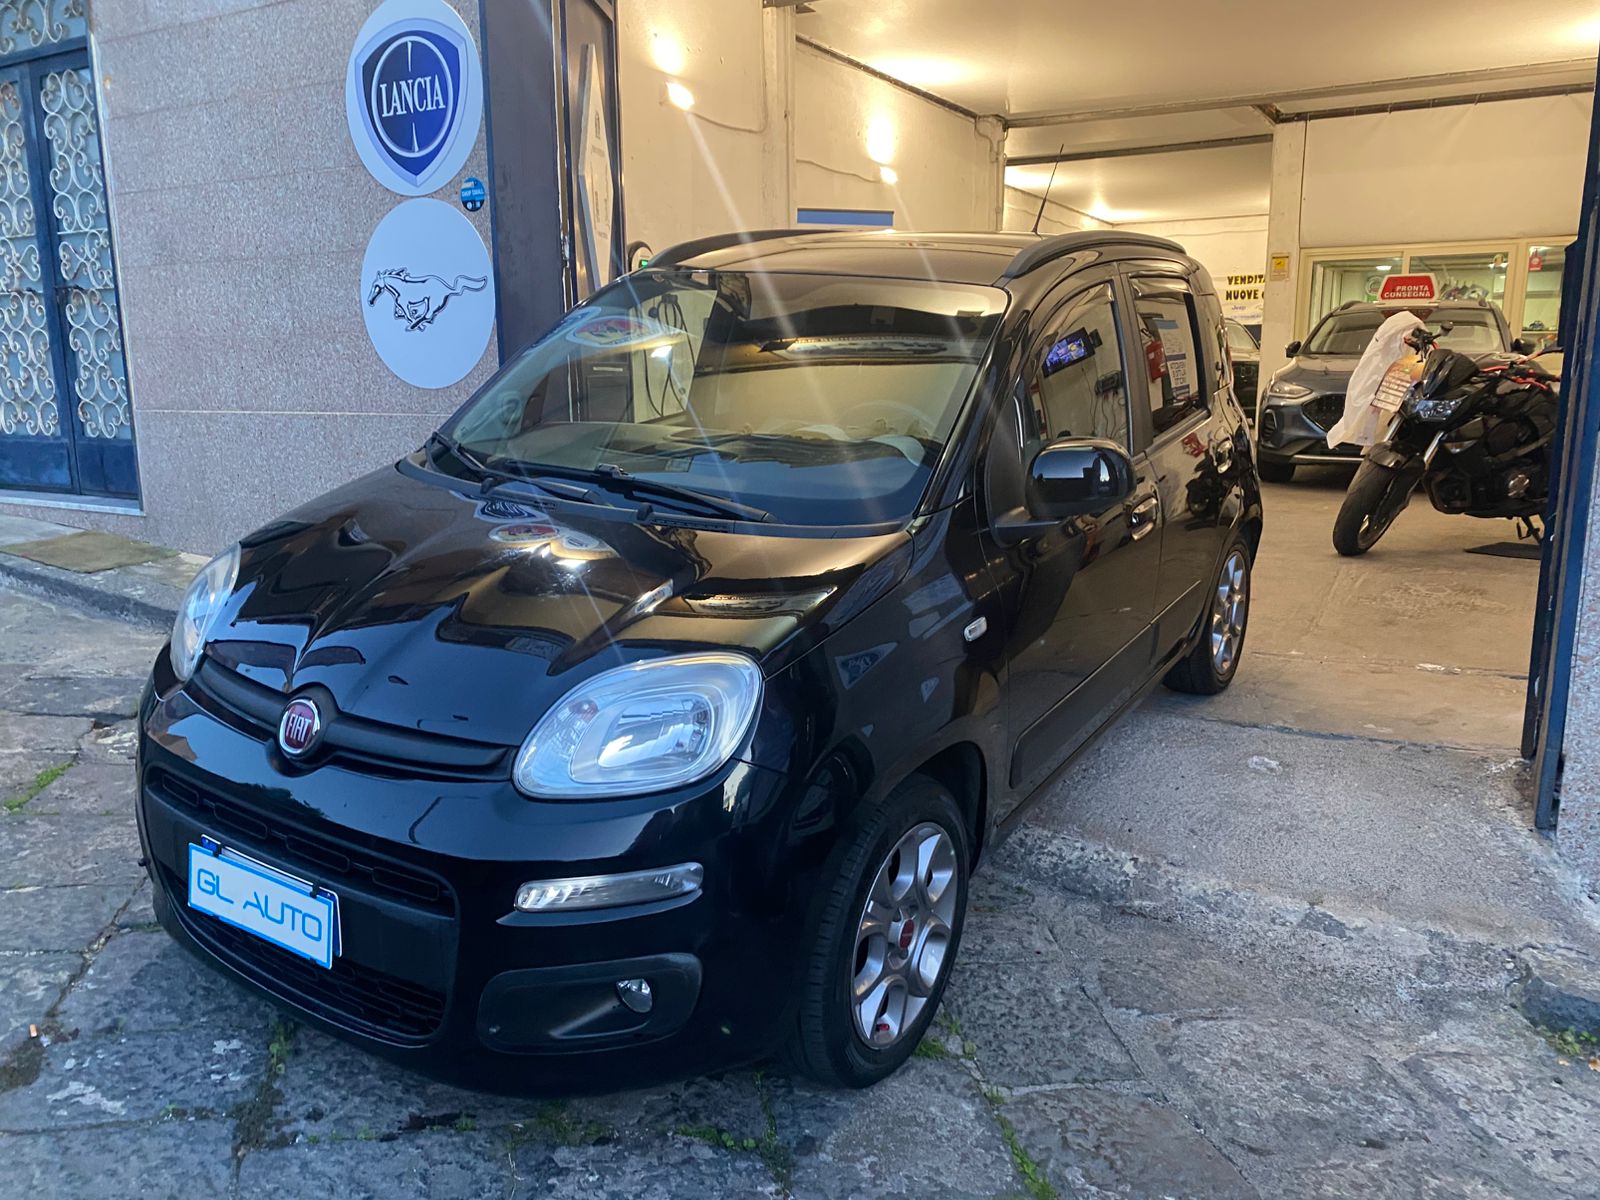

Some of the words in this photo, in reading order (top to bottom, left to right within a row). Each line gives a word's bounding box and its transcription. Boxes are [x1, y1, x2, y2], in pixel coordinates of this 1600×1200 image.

[380, 74, 446, 117] LANCIA
[1225, 289, 1259, 301] NUOVE
[286, 713, 312, 742] FIAT
[197, 868, 234, 904] GL
[243, 891, 322, 942] AUTO
